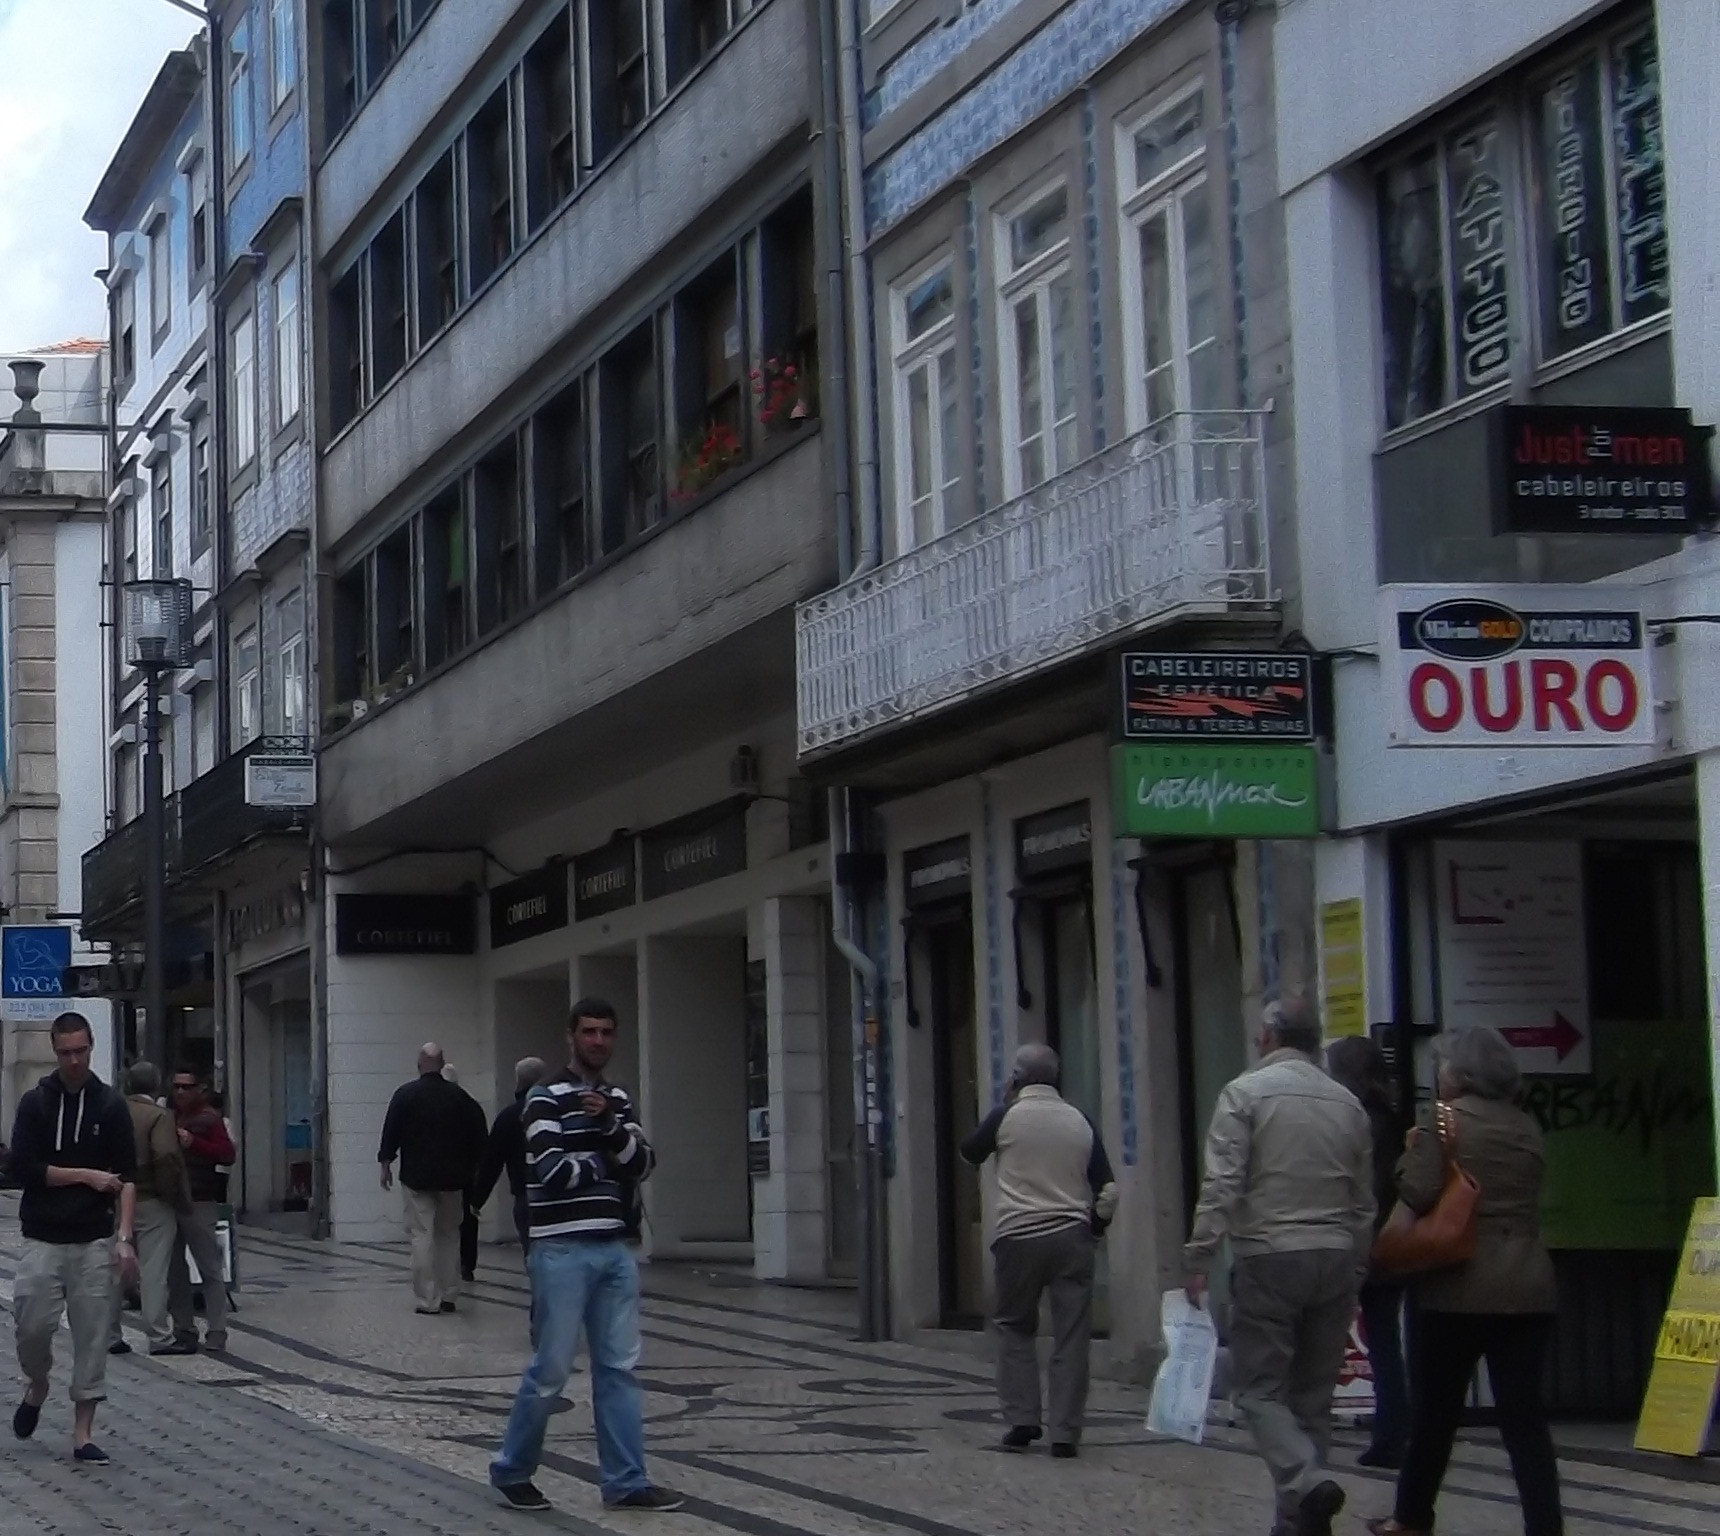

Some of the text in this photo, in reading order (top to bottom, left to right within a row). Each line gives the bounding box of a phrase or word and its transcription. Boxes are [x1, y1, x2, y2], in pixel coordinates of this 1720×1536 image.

[1454, 120, 1510, 387] TATTOO
[1516, 474, 1687, 498] cabeleireiros
[1131, 658, 1301, 678] CABELEIREIROS
[1408, 658, 1639, 733] OURO
[1202, 719, 1256, 732] TERESA
[663, 835, 718, 873] CORTEFIEL
[580, 865, 627, 901] CORTEFIEL
[506, 895, 547, 926] CORTEFIEL
[356, 929, 452, 946] CORTEFIEL
[9, 975, 64, 994] YOGA
